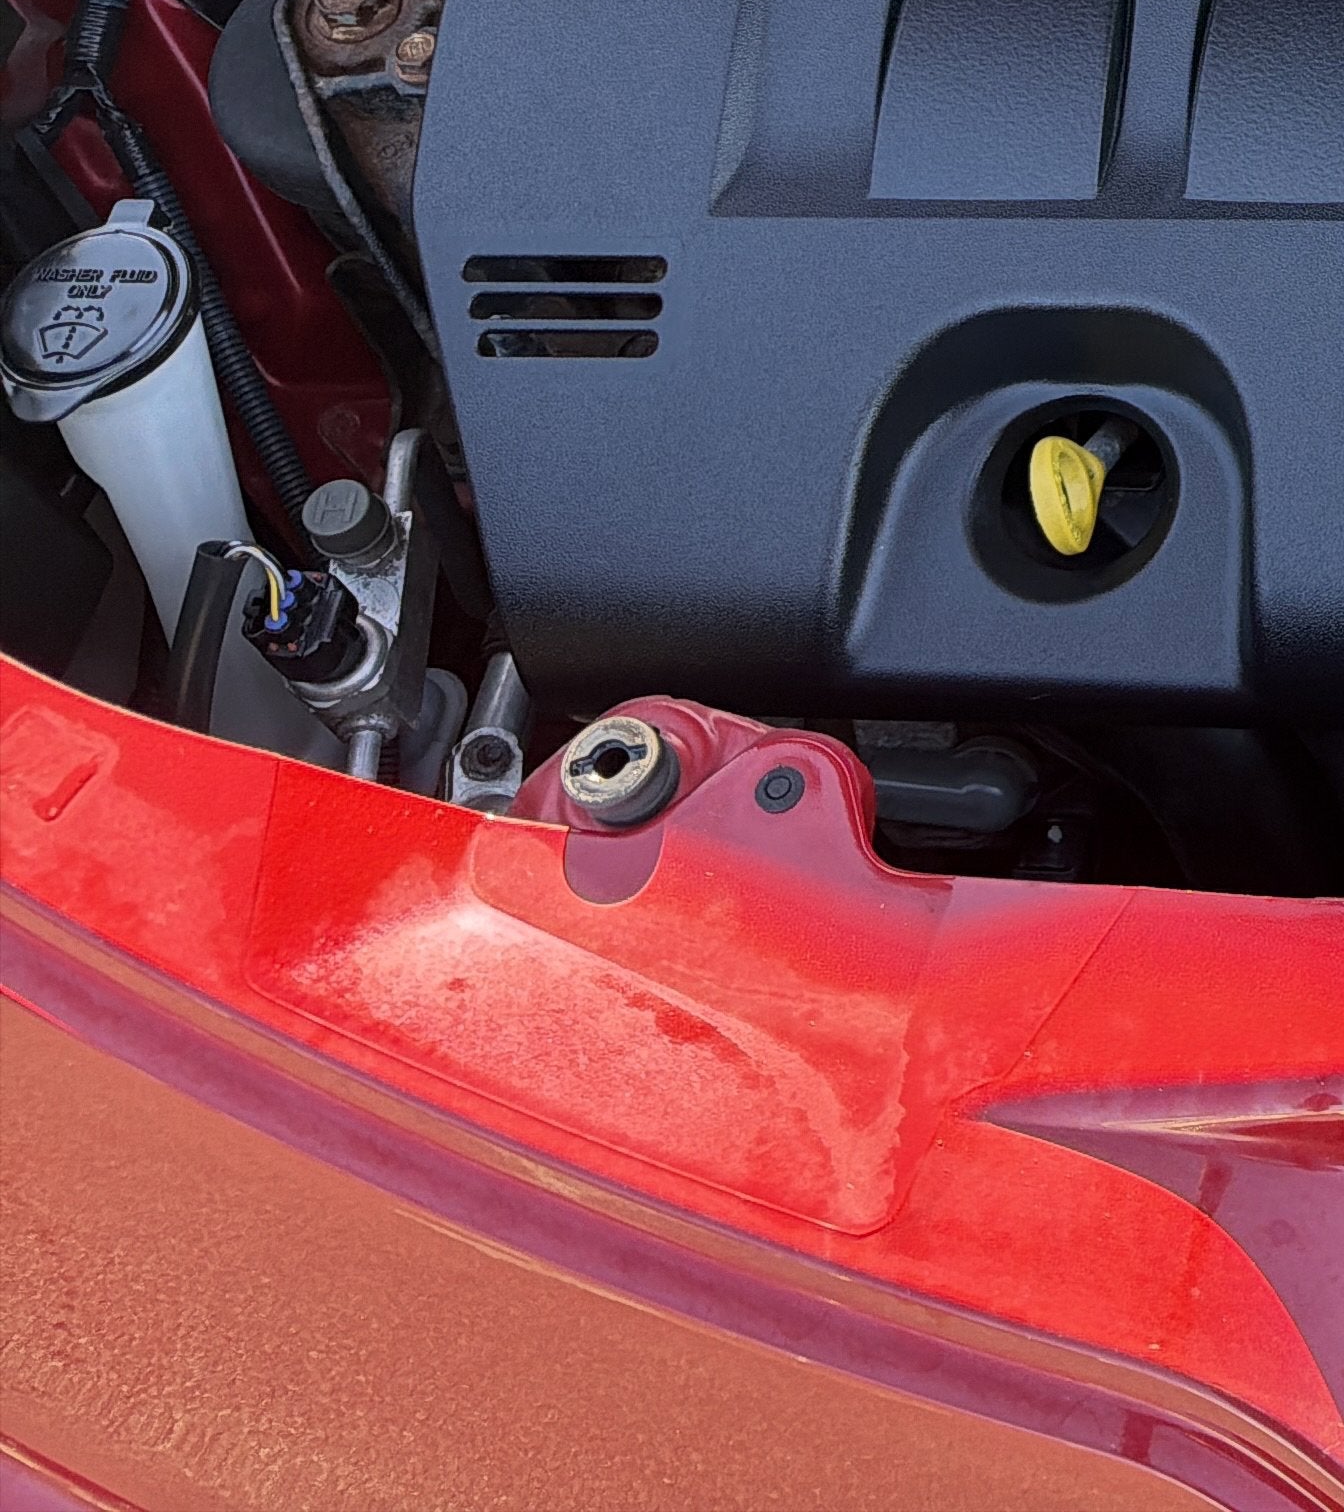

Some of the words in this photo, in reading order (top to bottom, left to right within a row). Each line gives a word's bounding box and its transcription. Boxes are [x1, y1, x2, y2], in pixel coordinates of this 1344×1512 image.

[34, 268, 105, 283] WASHER
[109, 269, 158, 284] FLUID
[67, 284, 112, 299] ONLY
